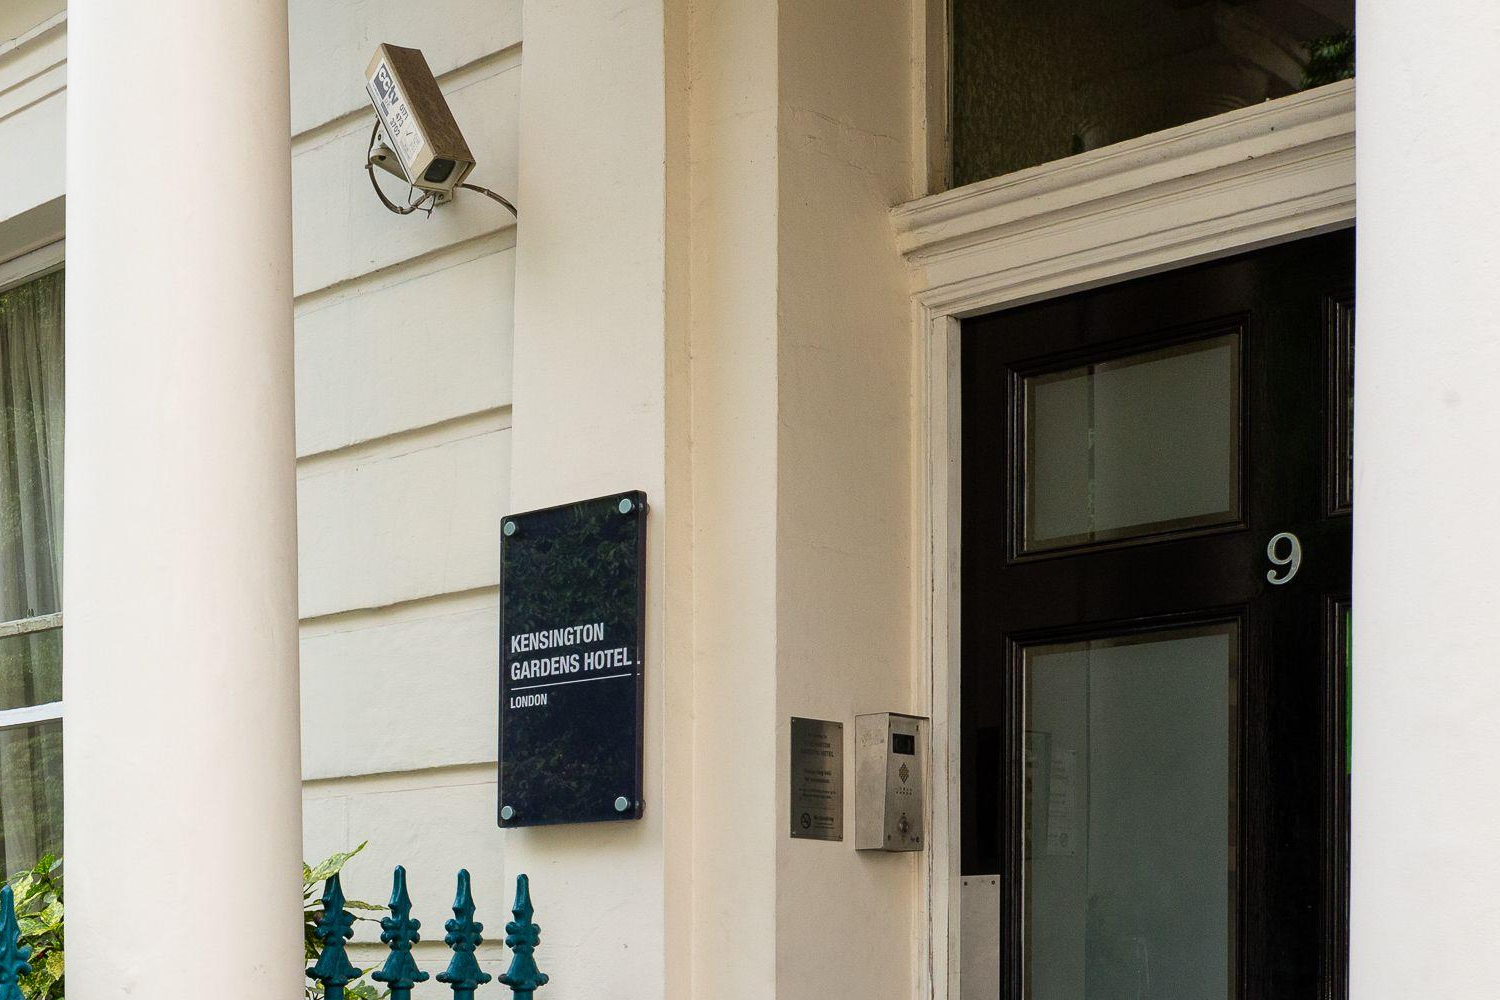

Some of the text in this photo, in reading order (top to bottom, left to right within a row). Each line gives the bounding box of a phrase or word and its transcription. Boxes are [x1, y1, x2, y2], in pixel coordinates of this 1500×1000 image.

[1266, 532, 1302, 585] 9
[511, 622, 604, 654] KENSINGTON
[511, 647, 632, 681] GARDENS HOTEL
[510, 693, 548, 709] LONDON
